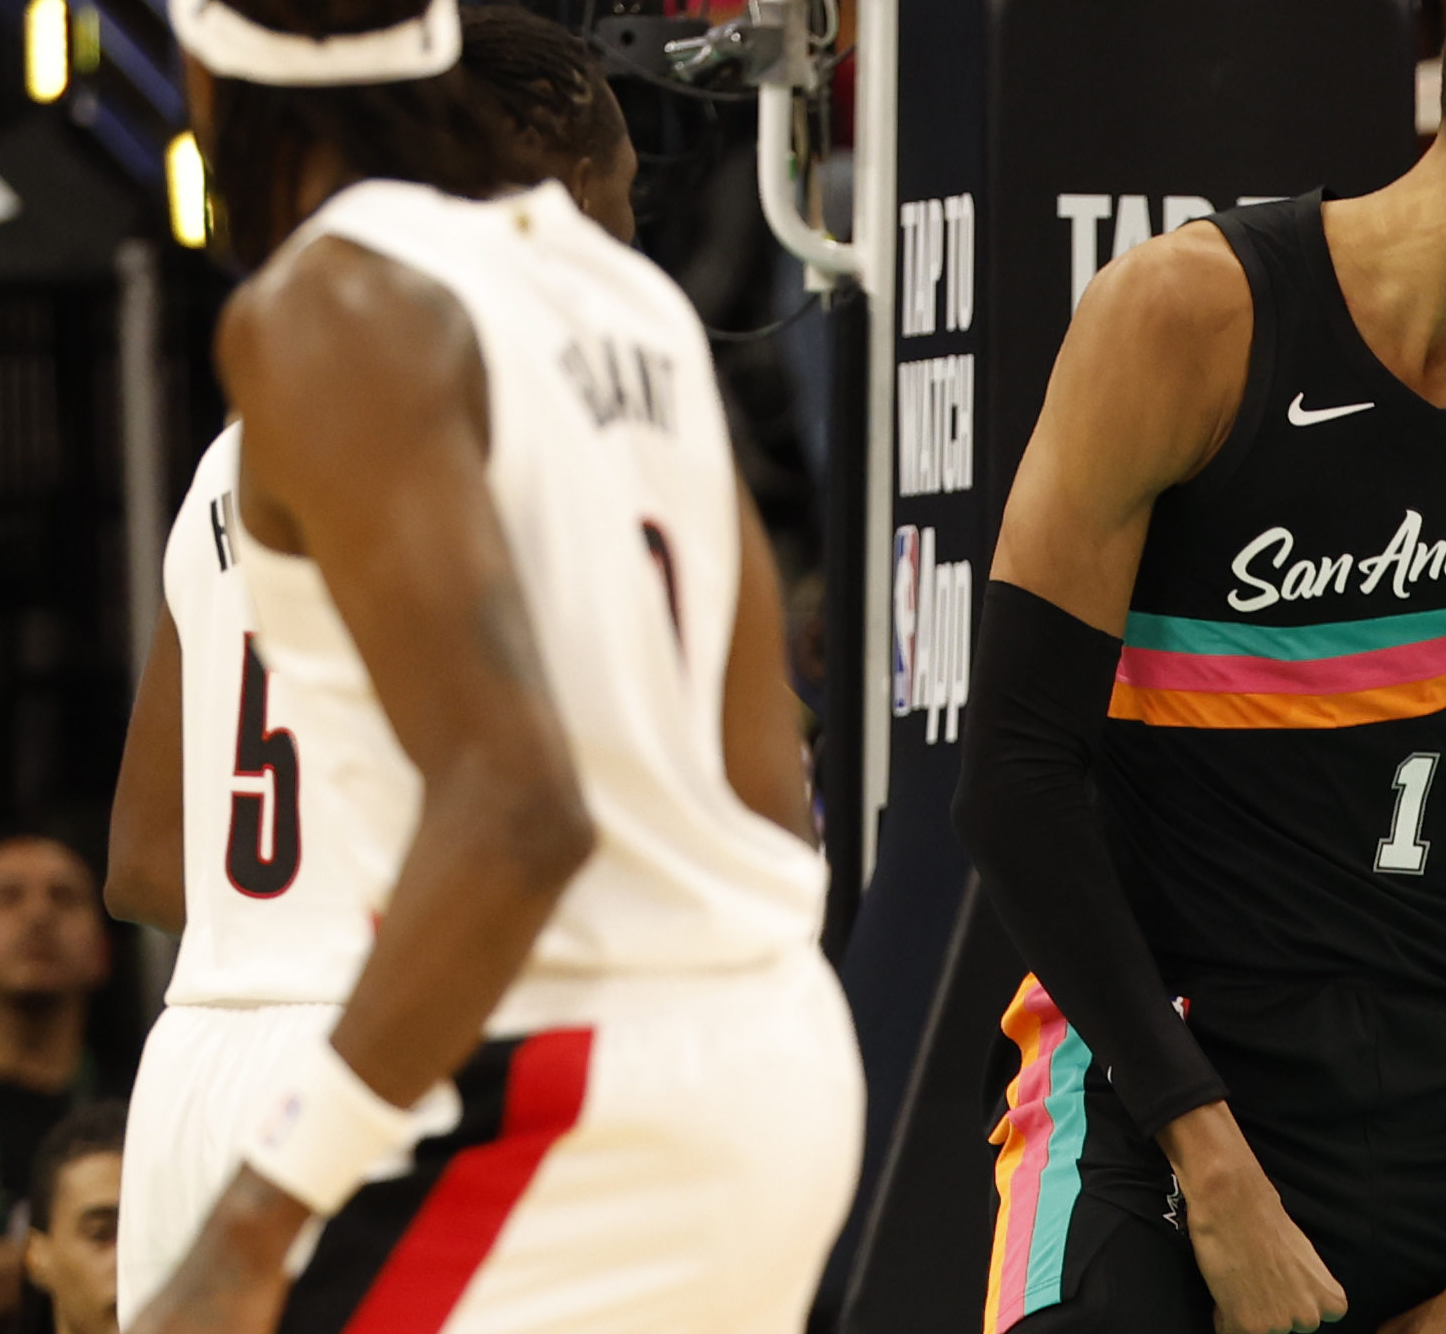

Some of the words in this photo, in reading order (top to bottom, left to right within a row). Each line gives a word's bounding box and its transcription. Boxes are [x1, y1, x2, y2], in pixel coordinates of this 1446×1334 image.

[900, 198, 944, 338] TAP
[944, 192, 975, 333] TO
[897, 353, 975, 497] WATCH
[1227, 526, 1354, 613] San
[225, 631, 302, 899] 5
[1373, 752, 1441, 875] 1
